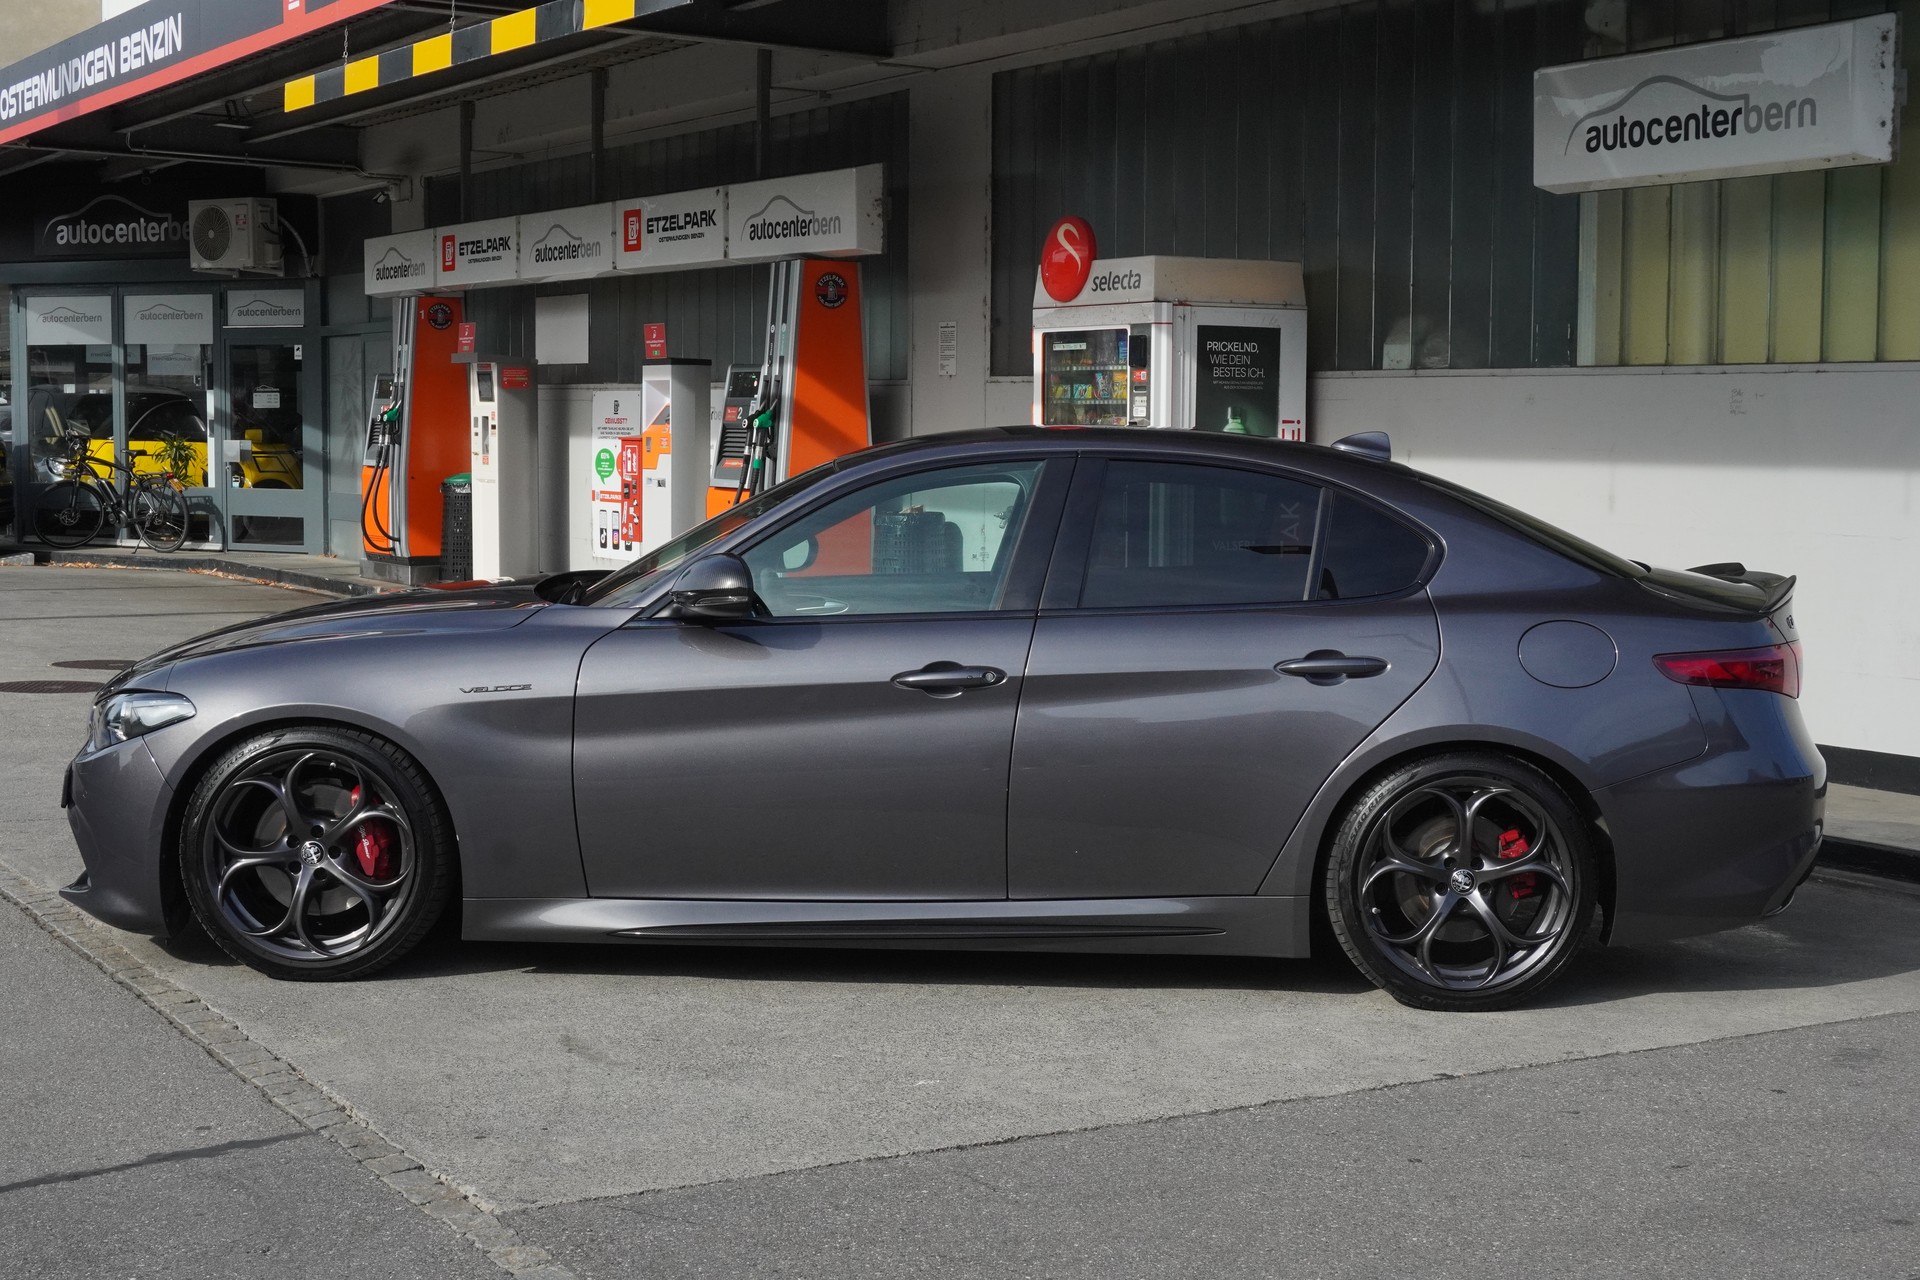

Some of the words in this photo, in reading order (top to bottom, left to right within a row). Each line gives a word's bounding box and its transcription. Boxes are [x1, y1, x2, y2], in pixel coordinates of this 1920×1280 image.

[0, 42, 115, 121] OSTERMUNDIGEN
[120, 13, 182, 74] BENZIN
[1585, 94, 1816, 153] autocenterbern
[647, 209, 716, 234] ETZELPARK
[749, 211, 841, 241] autocenterbern
[459, 236, 511, 256] ETZELPARK
[535, 237, 601, 263] autocenterbern
[376, 259, 426, 281] autocenterbern
[1091, 270, 1141, 292] selecta
[419, 310, 425, 319] 1
[1206, 341, 1259, 354] PRICKELND,
[1209, 354, 1228, 365] WIE
[1229, 354, 1251, 365] DEIN
[1213, 367, 1247, 378] BESTES
[1247, 368, 1266, 378] ICH.
[737, 406, 743, 419] 2
[459, 683, 532, 694] VELOCE
